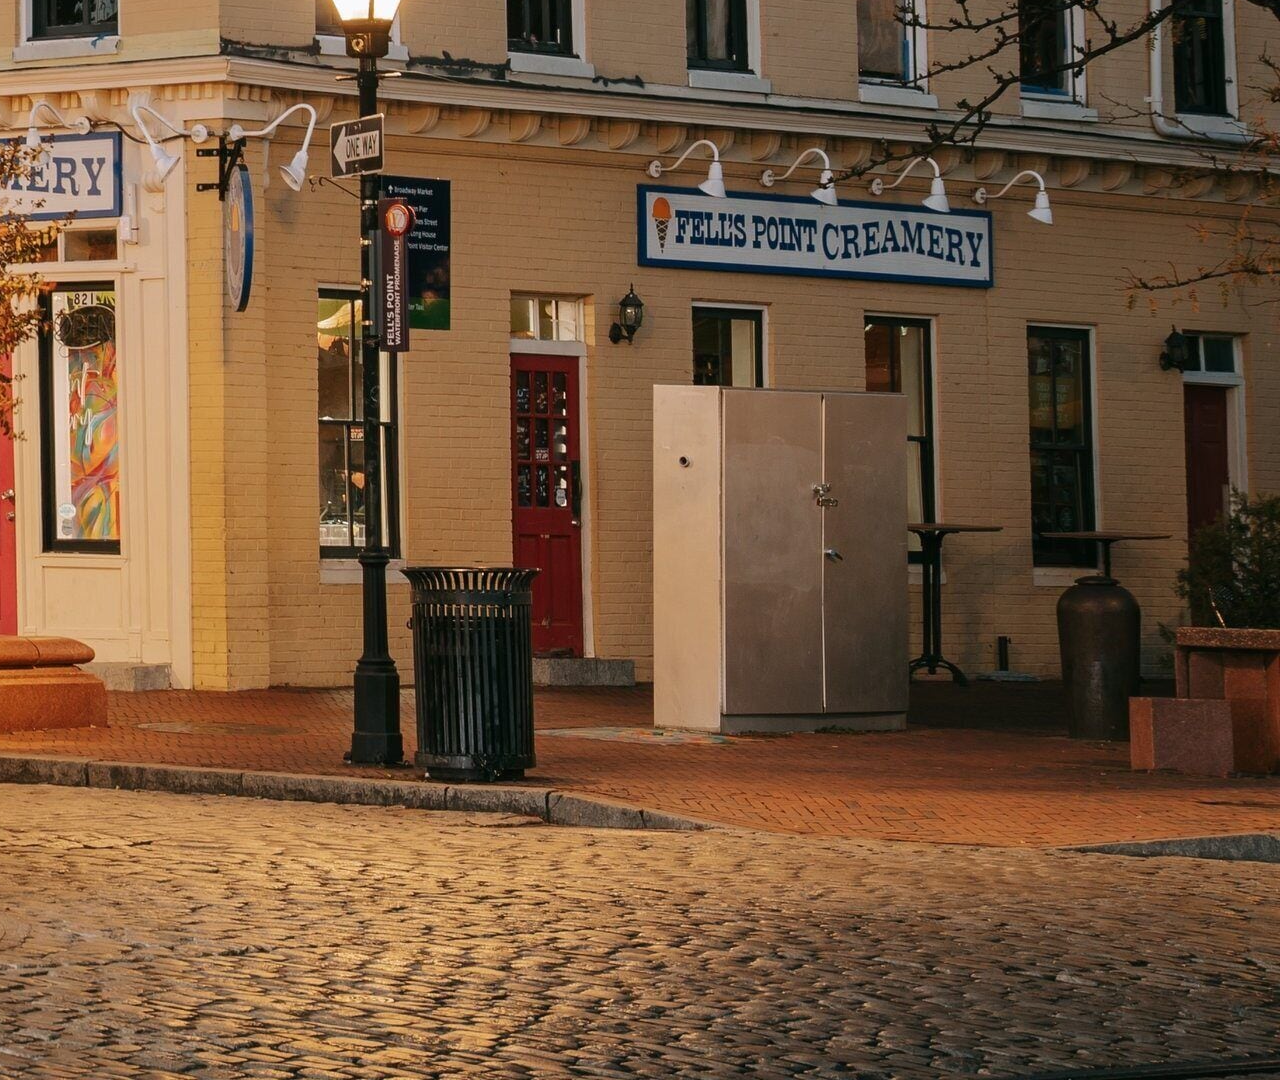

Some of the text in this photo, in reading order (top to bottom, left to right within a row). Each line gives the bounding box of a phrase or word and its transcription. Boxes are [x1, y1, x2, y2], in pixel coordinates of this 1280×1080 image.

[345, 134, 378, 159] ONE WAY
[394, 186, 433, 196] Broadway Market
[675, 210, 984, 268] FELL'S POINT CREAMERY
[74, 293, 94, 305] 821
[386, 274, 394, 308] POINT
